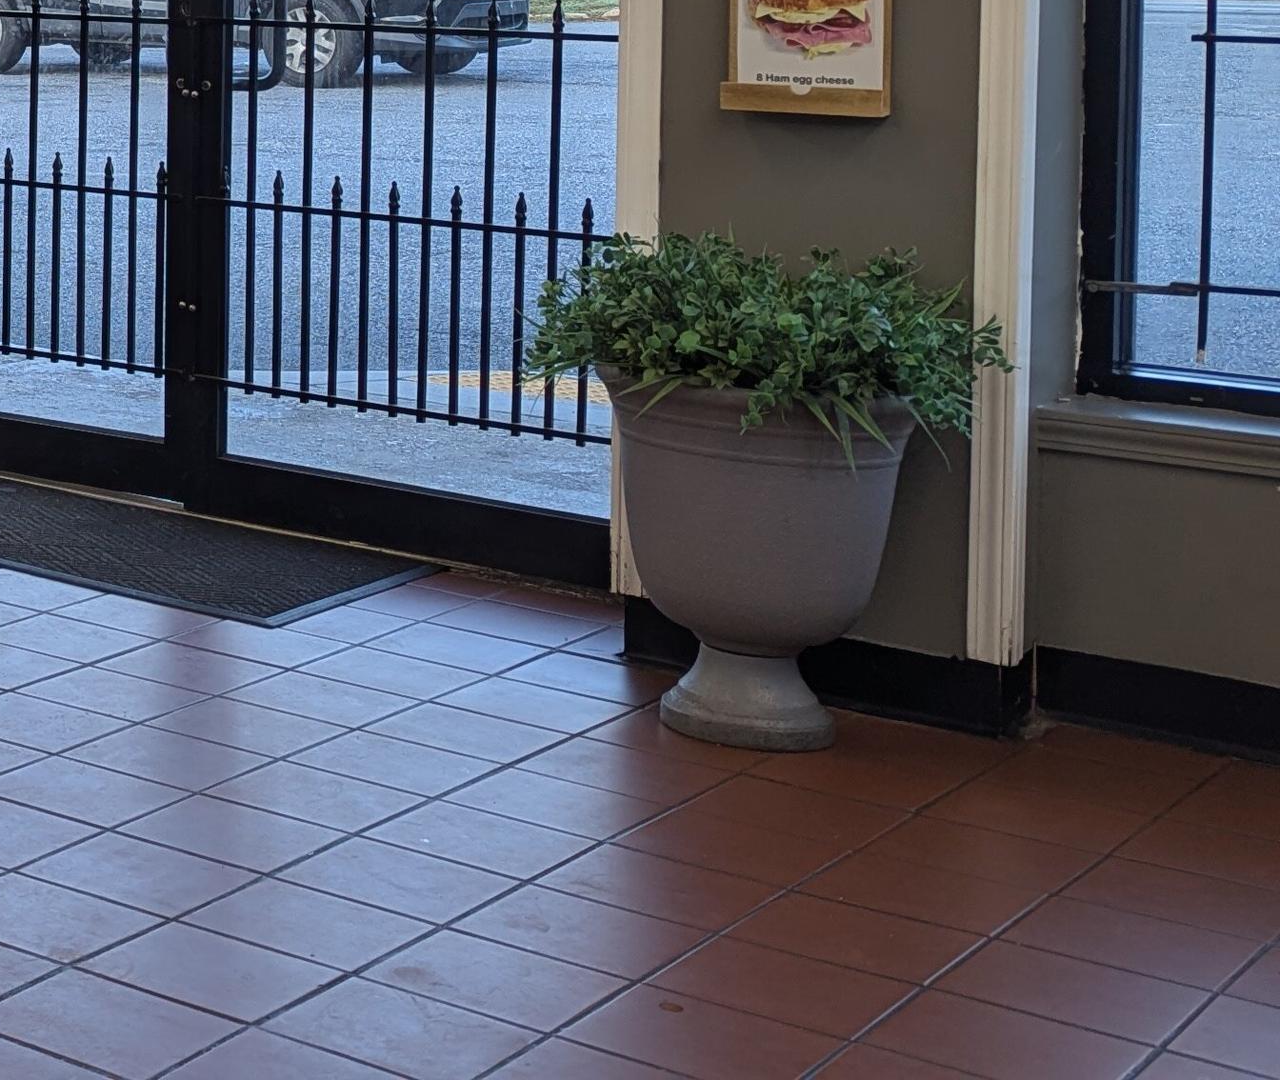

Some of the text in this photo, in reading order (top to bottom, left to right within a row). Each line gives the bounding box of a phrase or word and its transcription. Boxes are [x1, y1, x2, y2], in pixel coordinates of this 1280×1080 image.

[756, 73, 855, 85] 8 Ham egg cheese
